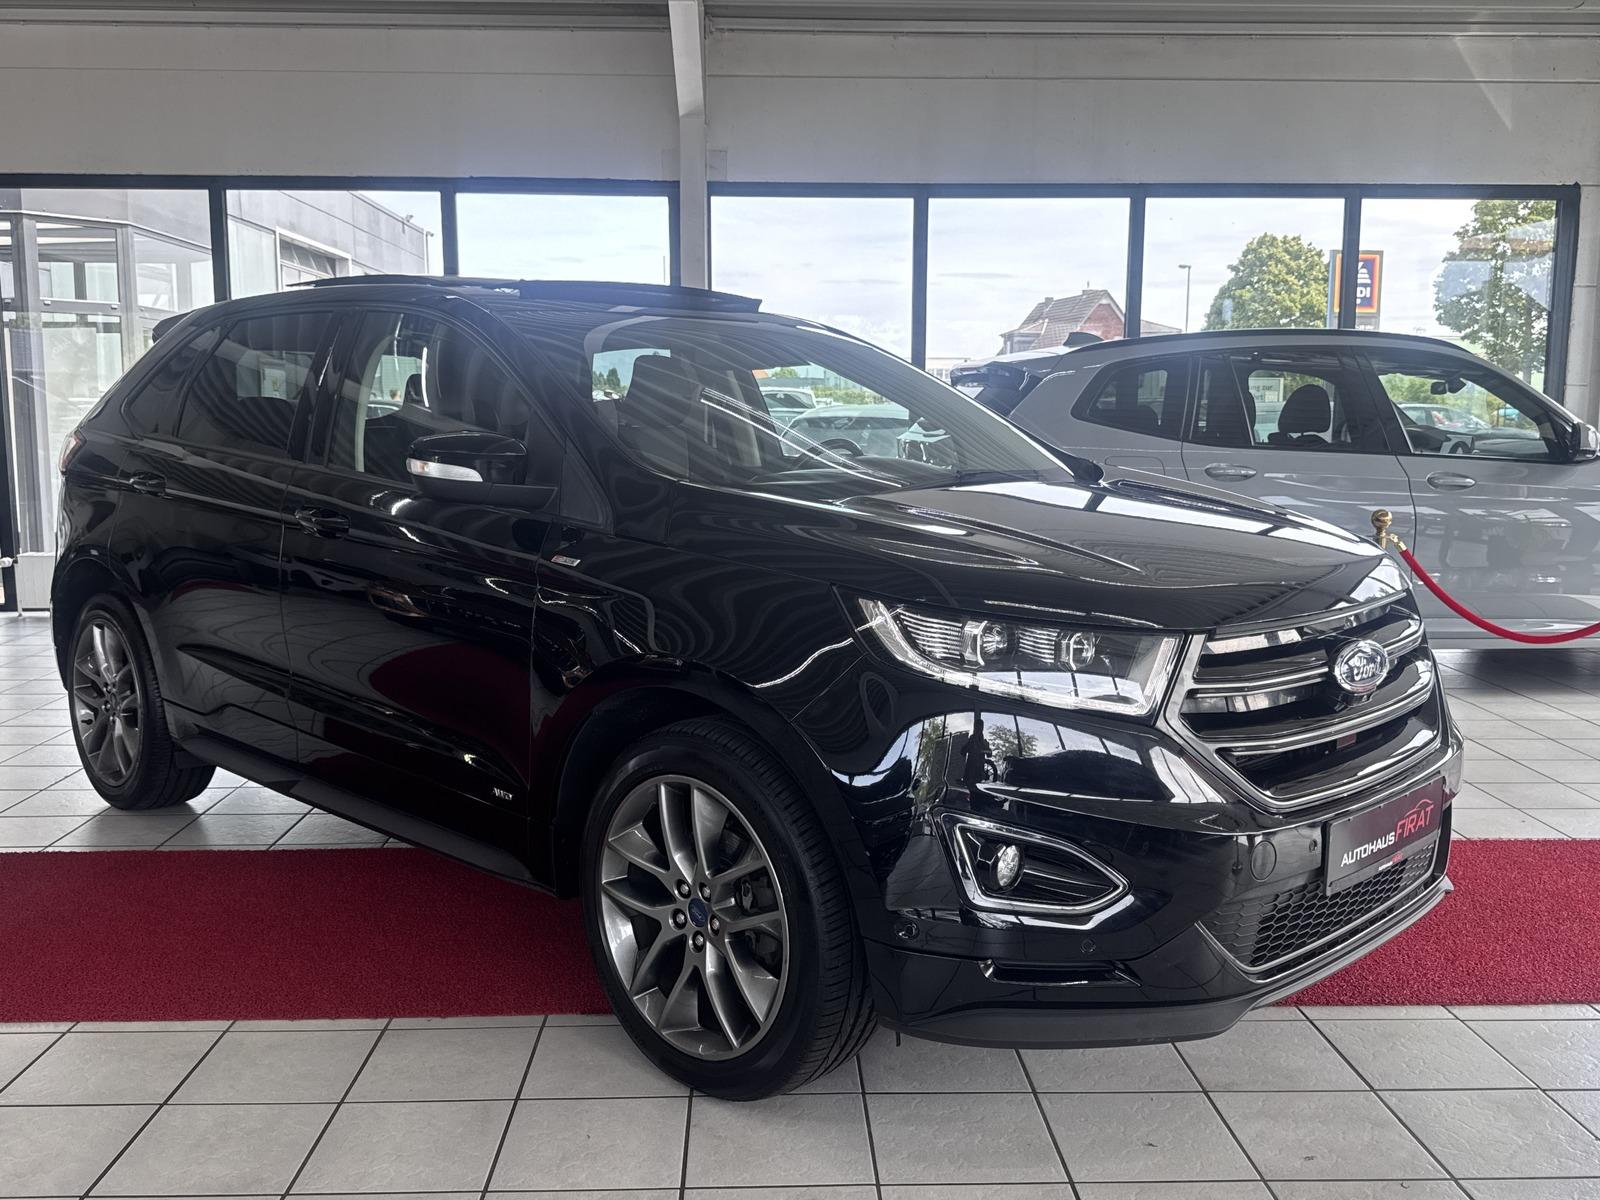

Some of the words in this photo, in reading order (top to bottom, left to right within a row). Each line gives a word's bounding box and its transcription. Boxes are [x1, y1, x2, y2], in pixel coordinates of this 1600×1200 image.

[1347, 652, 1384, 681] Ford
[1340, 832, 1396, 868] AUTOHAUS
[1395, 804, 1434, 842] FIRAT
